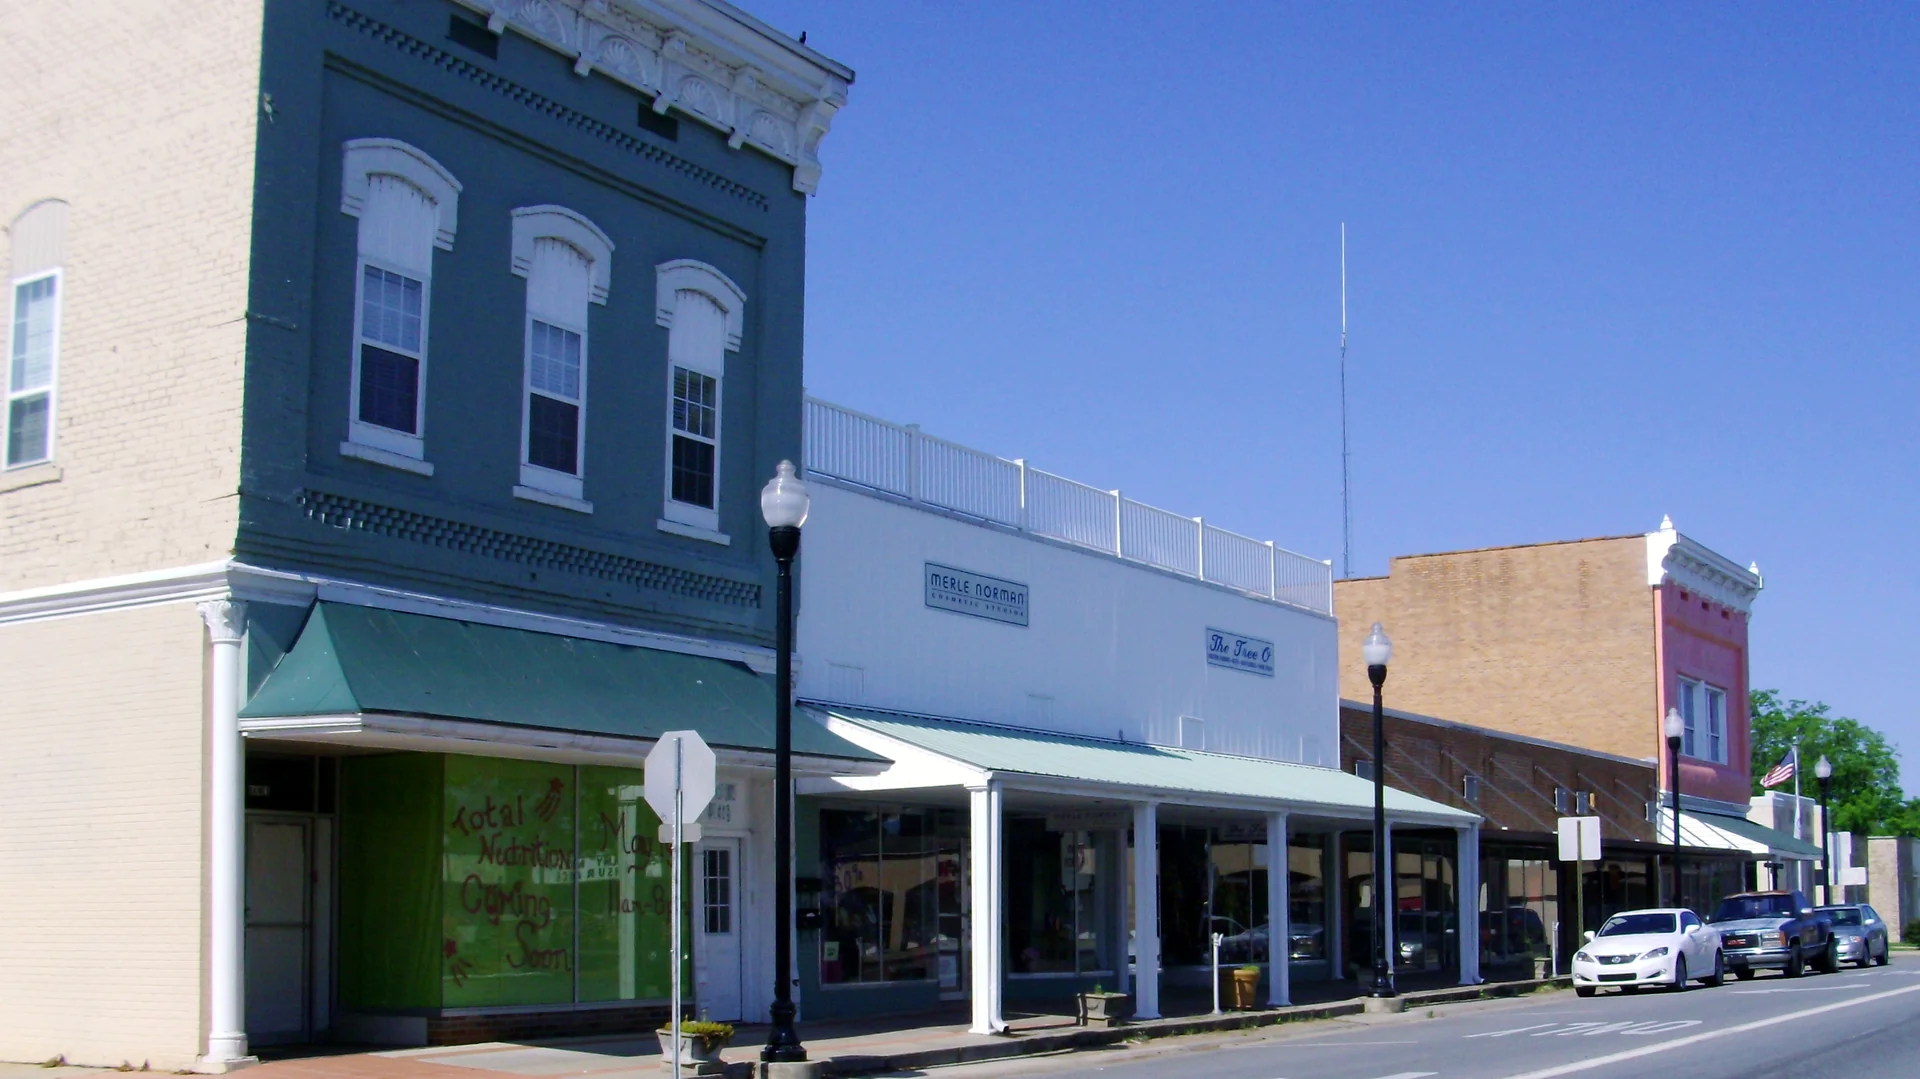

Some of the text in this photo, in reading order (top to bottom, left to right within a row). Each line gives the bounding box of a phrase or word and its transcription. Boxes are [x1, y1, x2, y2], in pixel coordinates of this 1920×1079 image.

[931, 573, 1024, 605] MERLE NORMAN
[1209, 634, 1230, 654] The
[1233, 639, 1258, 661] Tree
[452, 795, 523, 836] Total
[478, 831, 576, 870] Nutrition
[600, 811, 654, 873] May
[462, 873, 550, 928] Coming
[506, 919, 571, 972] Soon
